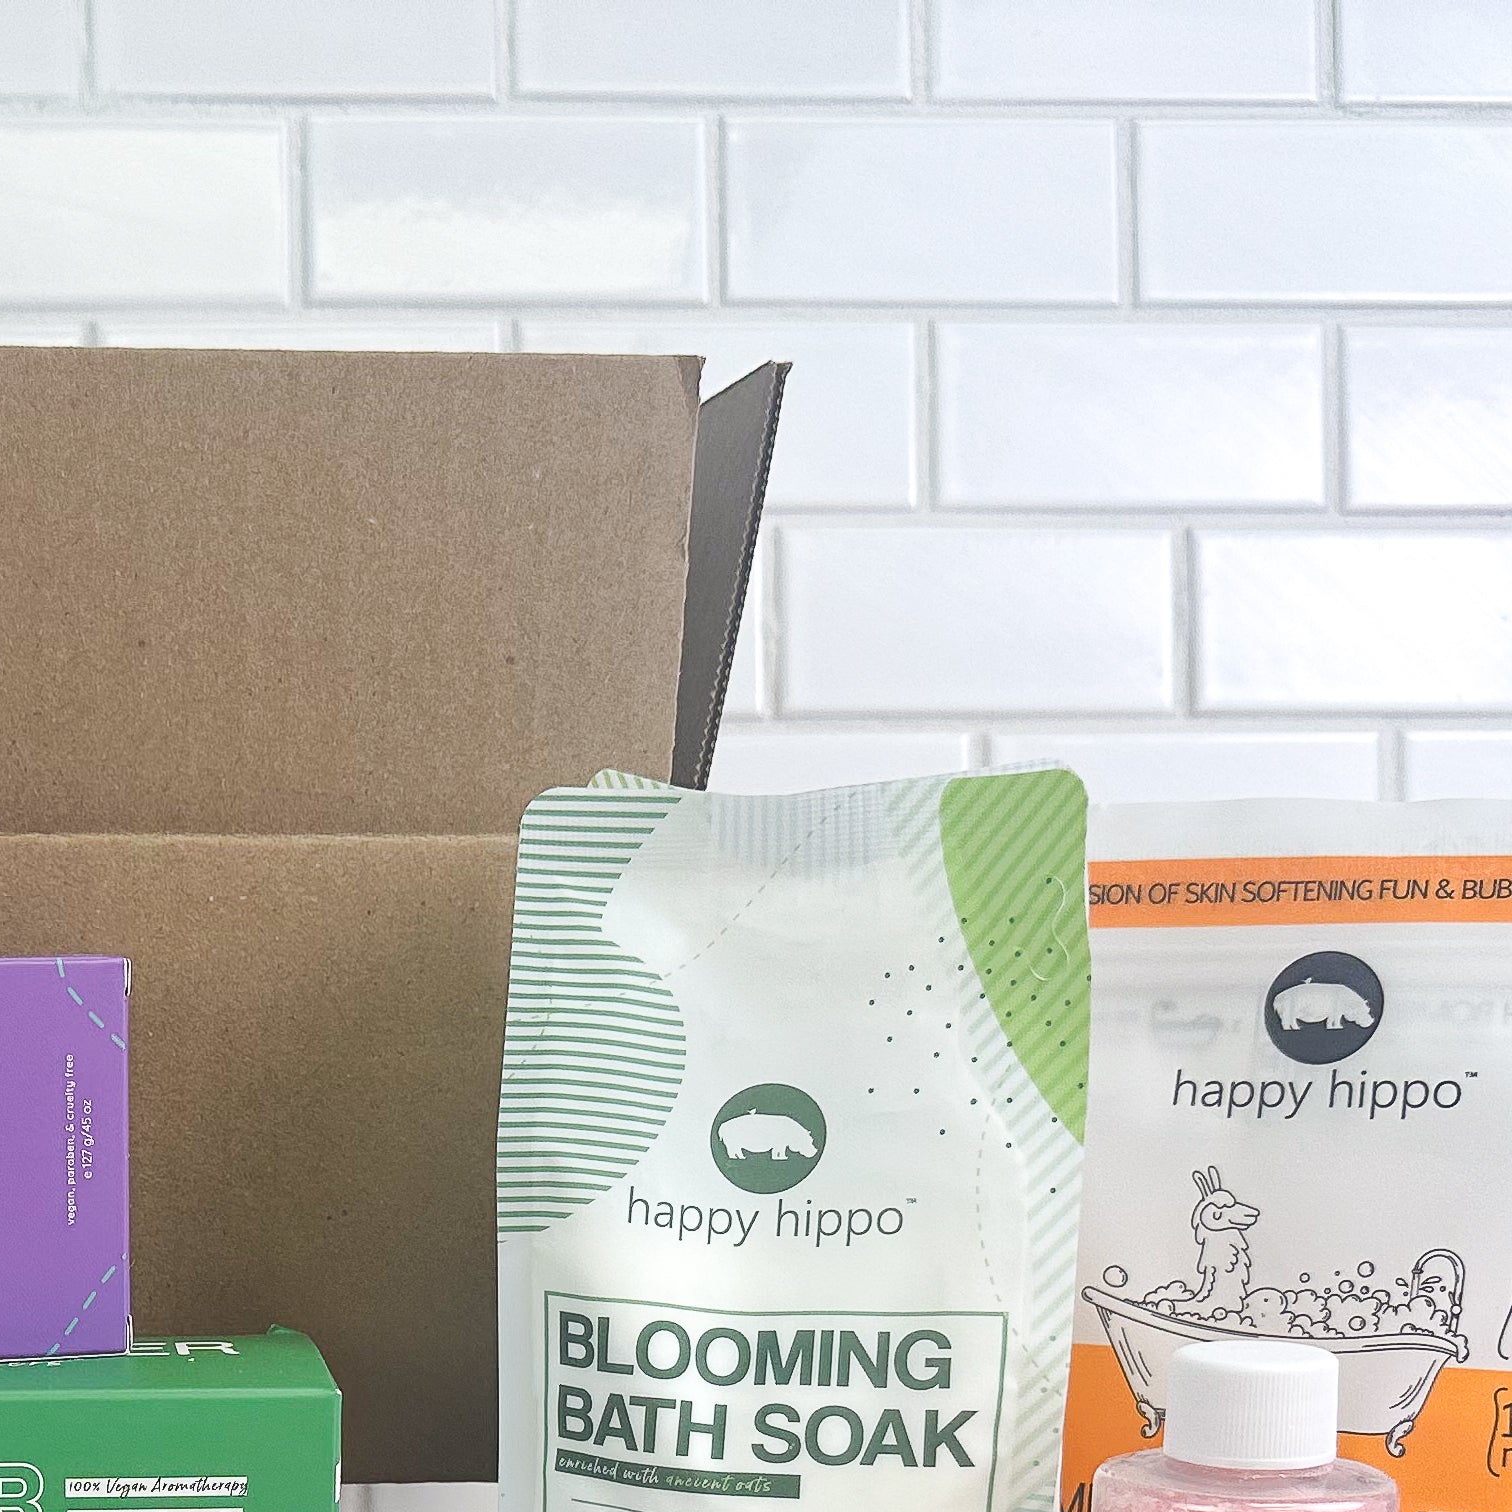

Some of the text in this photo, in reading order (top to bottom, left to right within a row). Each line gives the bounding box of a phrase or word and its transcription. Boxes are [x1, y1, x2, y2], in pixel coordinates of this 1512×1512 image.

[1089, 877, 1512, 905] SION OF SKIN SOFTENING FUN & BUB
[64, 1053, 75, 1079] free
[64, 1079, 77, 1123] cruelty
[83, 1098, 94, 1115] oz
[1172, 1069, 1463, 1120] happy hippo
[64, 1122, 76, 1134] &
[81, 1148, 94, 1170] 127
[626, 1185, 905, 1248] happy hippo
[557, 1309, 954, 1392] BLOOMING
[556, 1383, 980, 1470] BATH SOAK
[68, 1475, 248, 1499] 100% Vegan Aromatherapy
[558, 1456, 773, 1493] enriched with ancient oats
